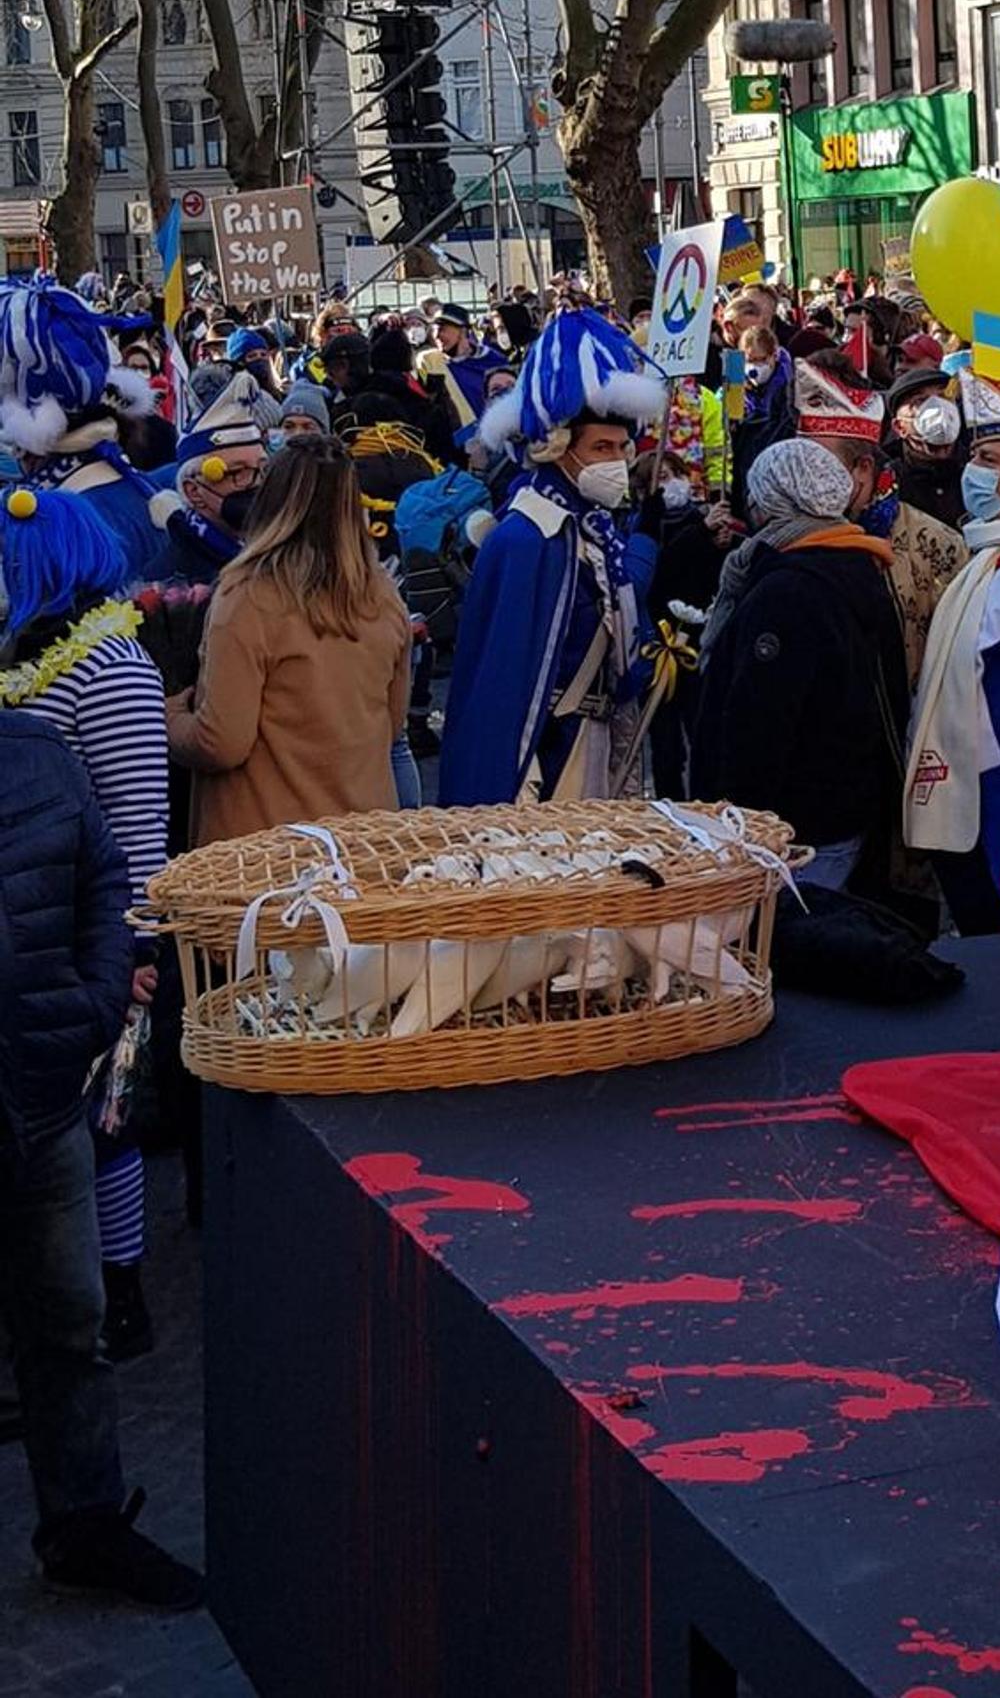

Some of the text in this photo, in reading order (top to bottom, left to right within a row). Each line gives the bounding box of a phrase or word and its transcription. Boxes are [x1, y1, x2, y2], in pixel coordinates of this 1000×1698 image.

[821, 127, 908, 171] SUBWAY
[223, 202, 303, 235] Putin
[228, 240, 288, 266] Stop
[230, 264, 320, 294] the War
[652, 336, 696, 363] PEACE
